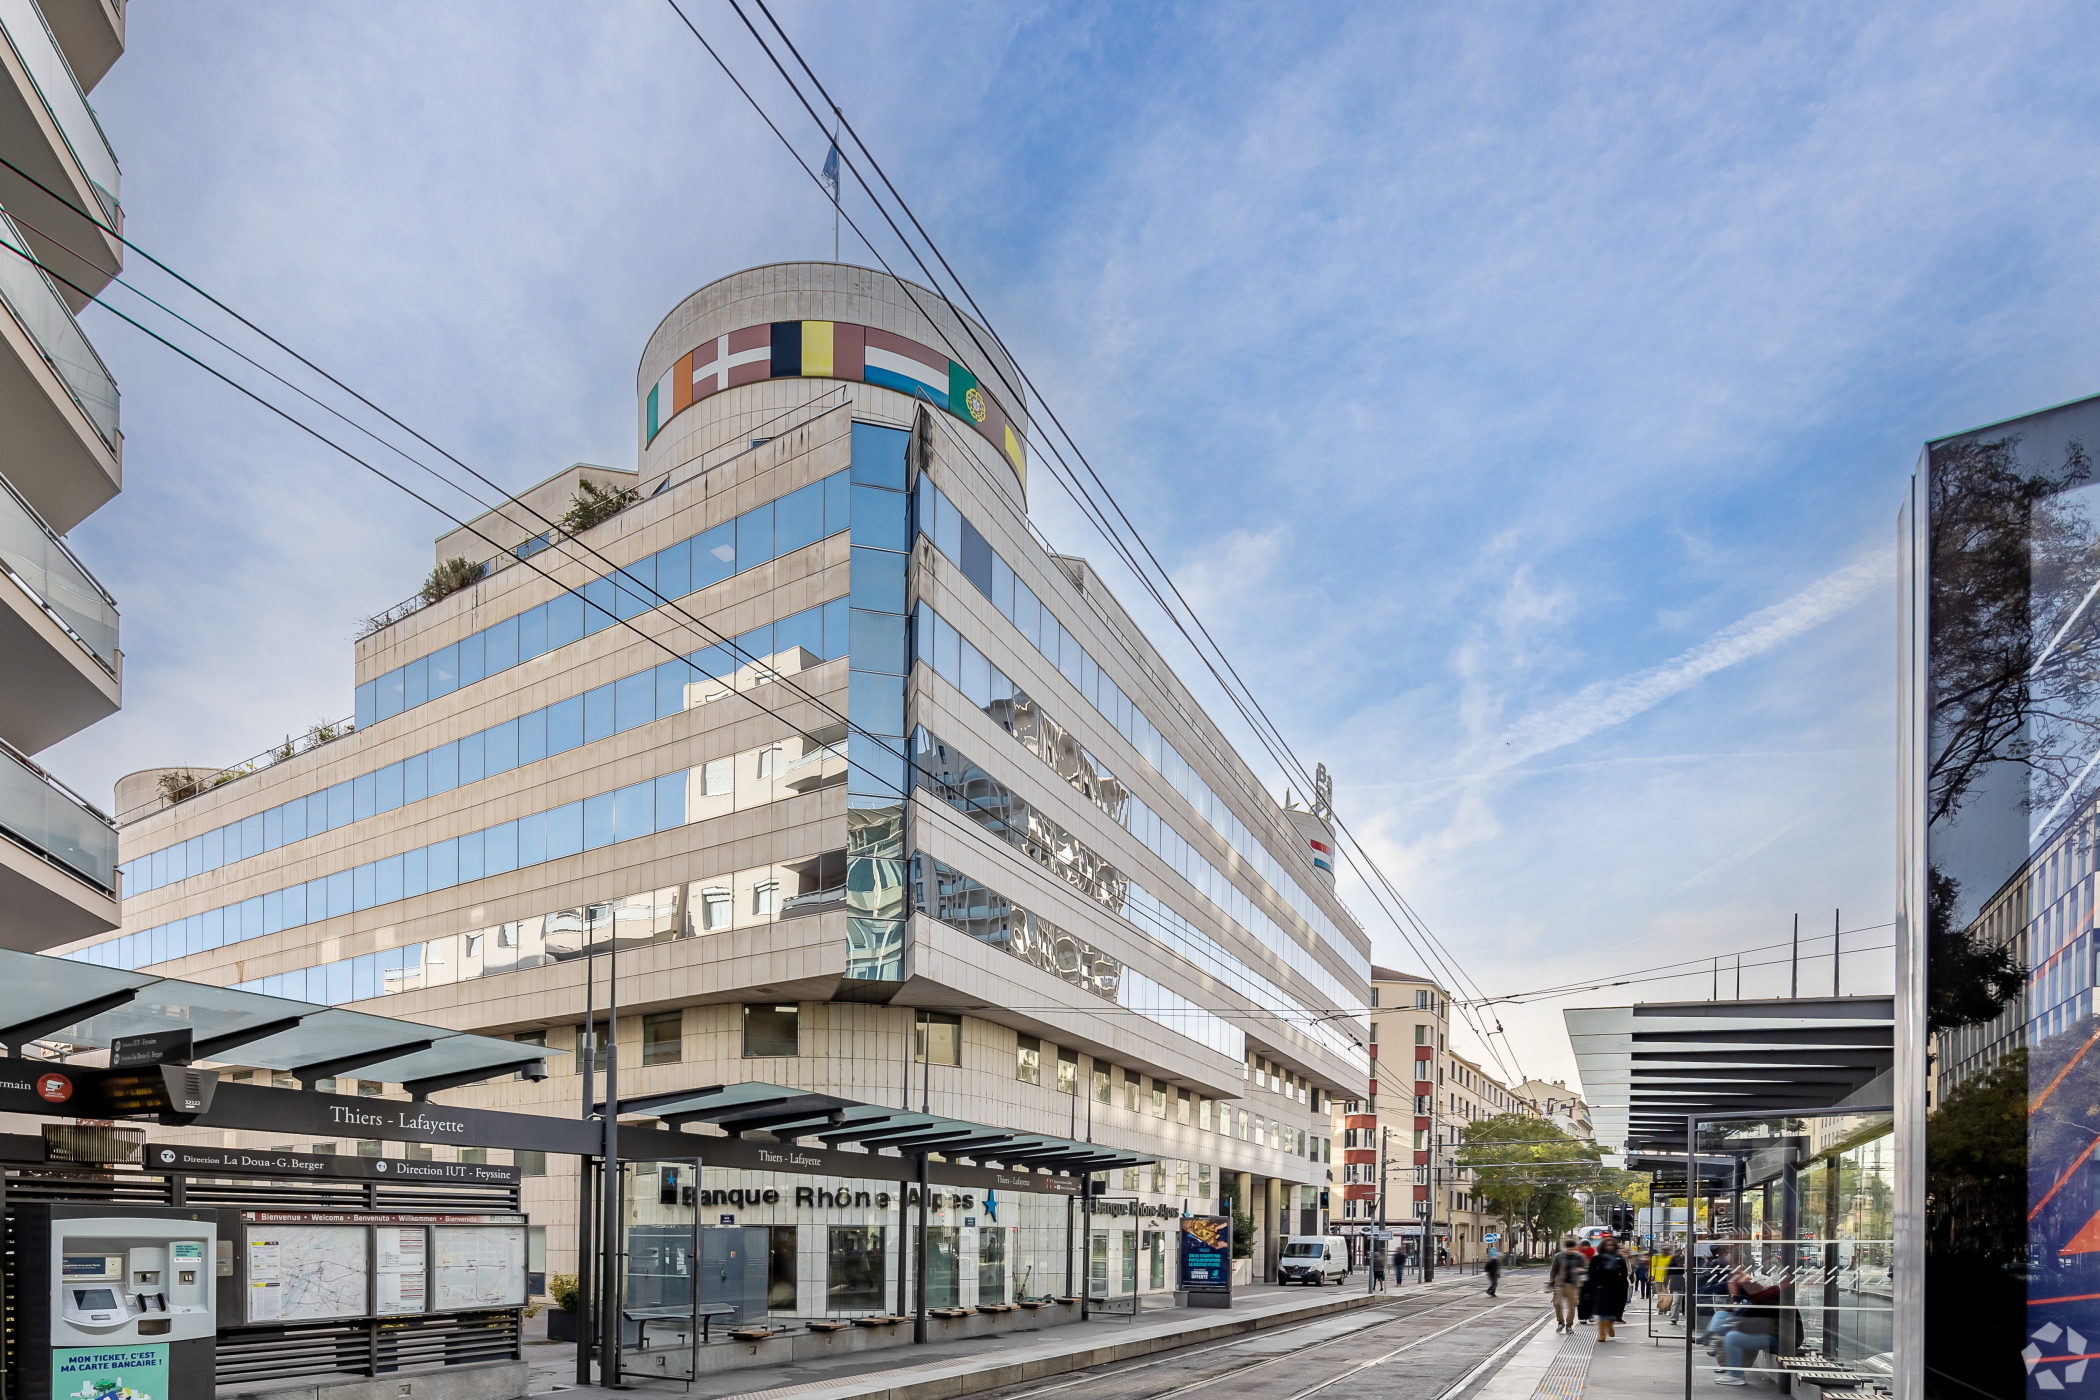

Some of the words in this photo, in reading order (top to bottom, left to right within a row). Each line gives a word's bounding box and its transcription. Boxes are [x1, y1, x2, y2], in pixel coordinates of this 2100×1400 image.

[330, 1105, 383, 1126] Thiers
[398, 1112, 465, 1135] Lafayette
[161, 1152, 175, 1160] T4
[183, 1154, 220, 1164] Direction
[223, 1155, 238, 1165] La
[758, 1149, 783, 1162] Thiers
[790, 1152, 822, 1167] Lafayette
[396, 1162, 443, 1176] Direction
[445, 1165, 467, 1177] IUT
[475, 1167, 511, 1181] Feyssine
[682, 1186, 780, 1210] Banque
[261, 1212, 301, 1221] Bienvenue
[311, 1213, 344, 1221] Welcome
[353, 1214, 390, 1222] Benvenuto
[1094, 1200, 1128, 1218] Banque
[60, 1364, 77, 1373] MA
[78, 1362, 110, 1371] CARTE
[111, 1359, 157, 1369] BANCAIRE
[68, 1355, 91, 1364] MON
[93, 1353, 128, 1362] TICKET,
[130, 1351, 156, 1360] C'EST
